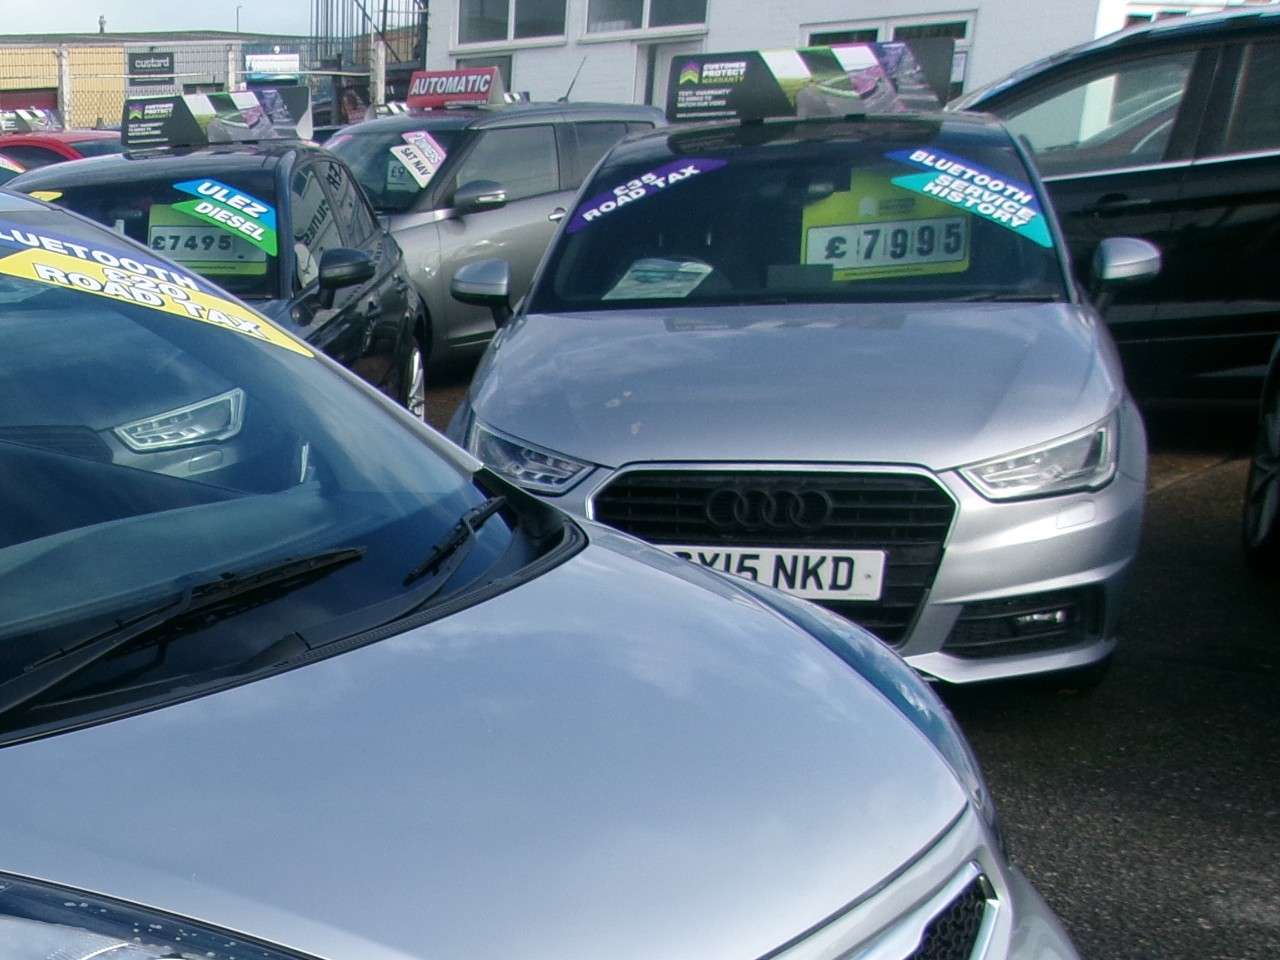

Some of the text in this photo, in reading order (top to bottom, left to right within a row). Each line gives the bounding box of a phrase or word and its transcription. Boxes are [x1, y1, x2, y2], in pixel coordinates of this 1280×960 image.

[135, 57, 169, 68] custard
[702, 69, 746, 77] PROTECT
[410, 74, 491, 95] AUTOMATIC
[400, 147, 431, 176] SAT NAV
[909, 150, 1034, 205] BLUETOOTH
[196, 182, 269, 218] ULEZ
[582, 165, 702, 222] ROAD TAX
[613, 172, 658, 196] £35
[935, 173, 1037, 220] SERVICE
[194, 202, 265, 241] DIESEL
[922, 183, 1029, 228] HISTORY
[151, 235, 233, 251] £7495
[825, 223, 961, 260] £7995
[33, 262, 268, 338] ROAD TAX
[102, 267, 189, 301] £20
[772, 554, 855, 591] NKD
